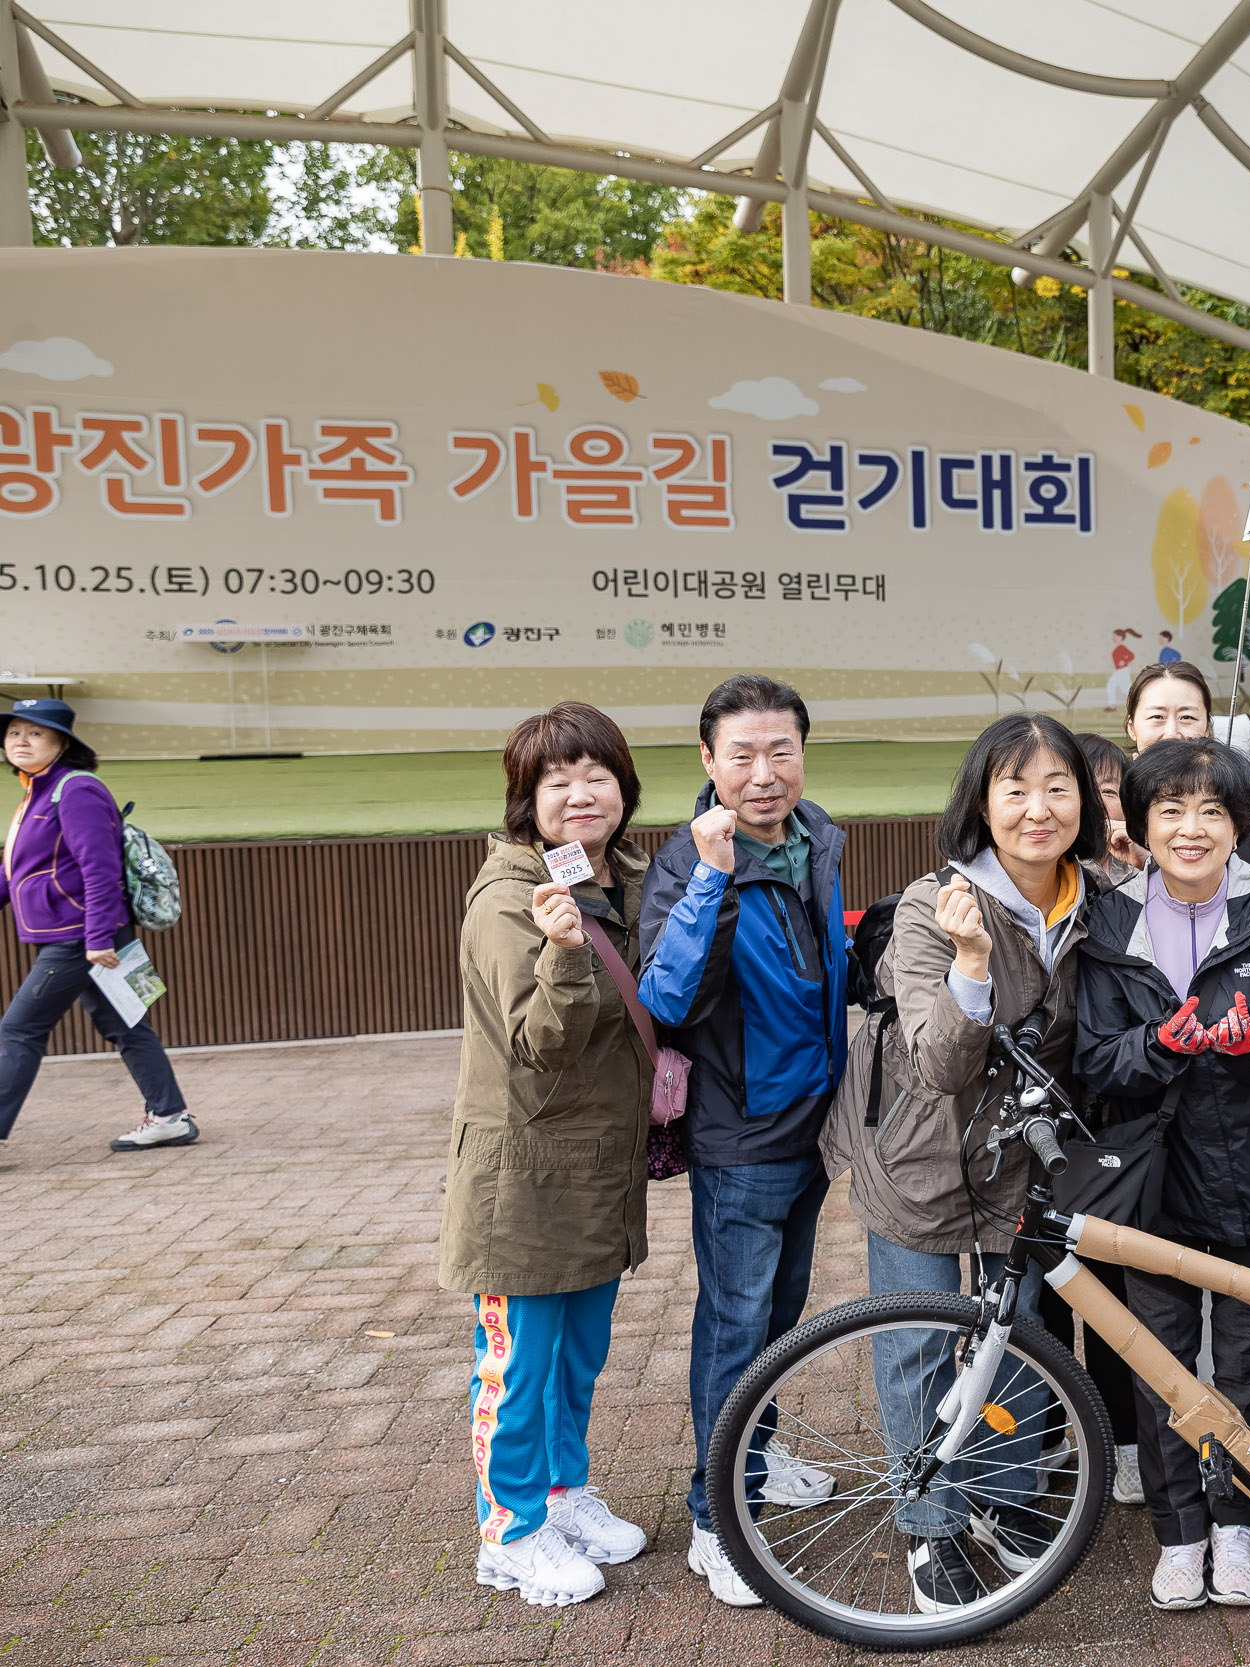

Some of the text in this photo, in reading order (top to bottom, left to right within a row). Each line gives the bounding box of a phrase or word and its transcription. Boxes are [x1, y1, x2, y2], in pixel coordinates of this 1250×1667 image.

[0, 408, 1093, 534] 광진가족 가을길 걷기대회
[223, 566, 436, 595] 07:30~09:30
[592, 568, 887, 602] 어린이대공원 열린무대
[319, 623, 392, 638] 광진구체육회
[434, 628, 457, 641] 후원
[502, 626, 562, 642] 광진구
[596, 628, 617, 640] 협찬
[660, 622, 727, 639] 혜민병원
[547, 852, 559, 860] 2025
[560, 864, 583, 879] 2925
